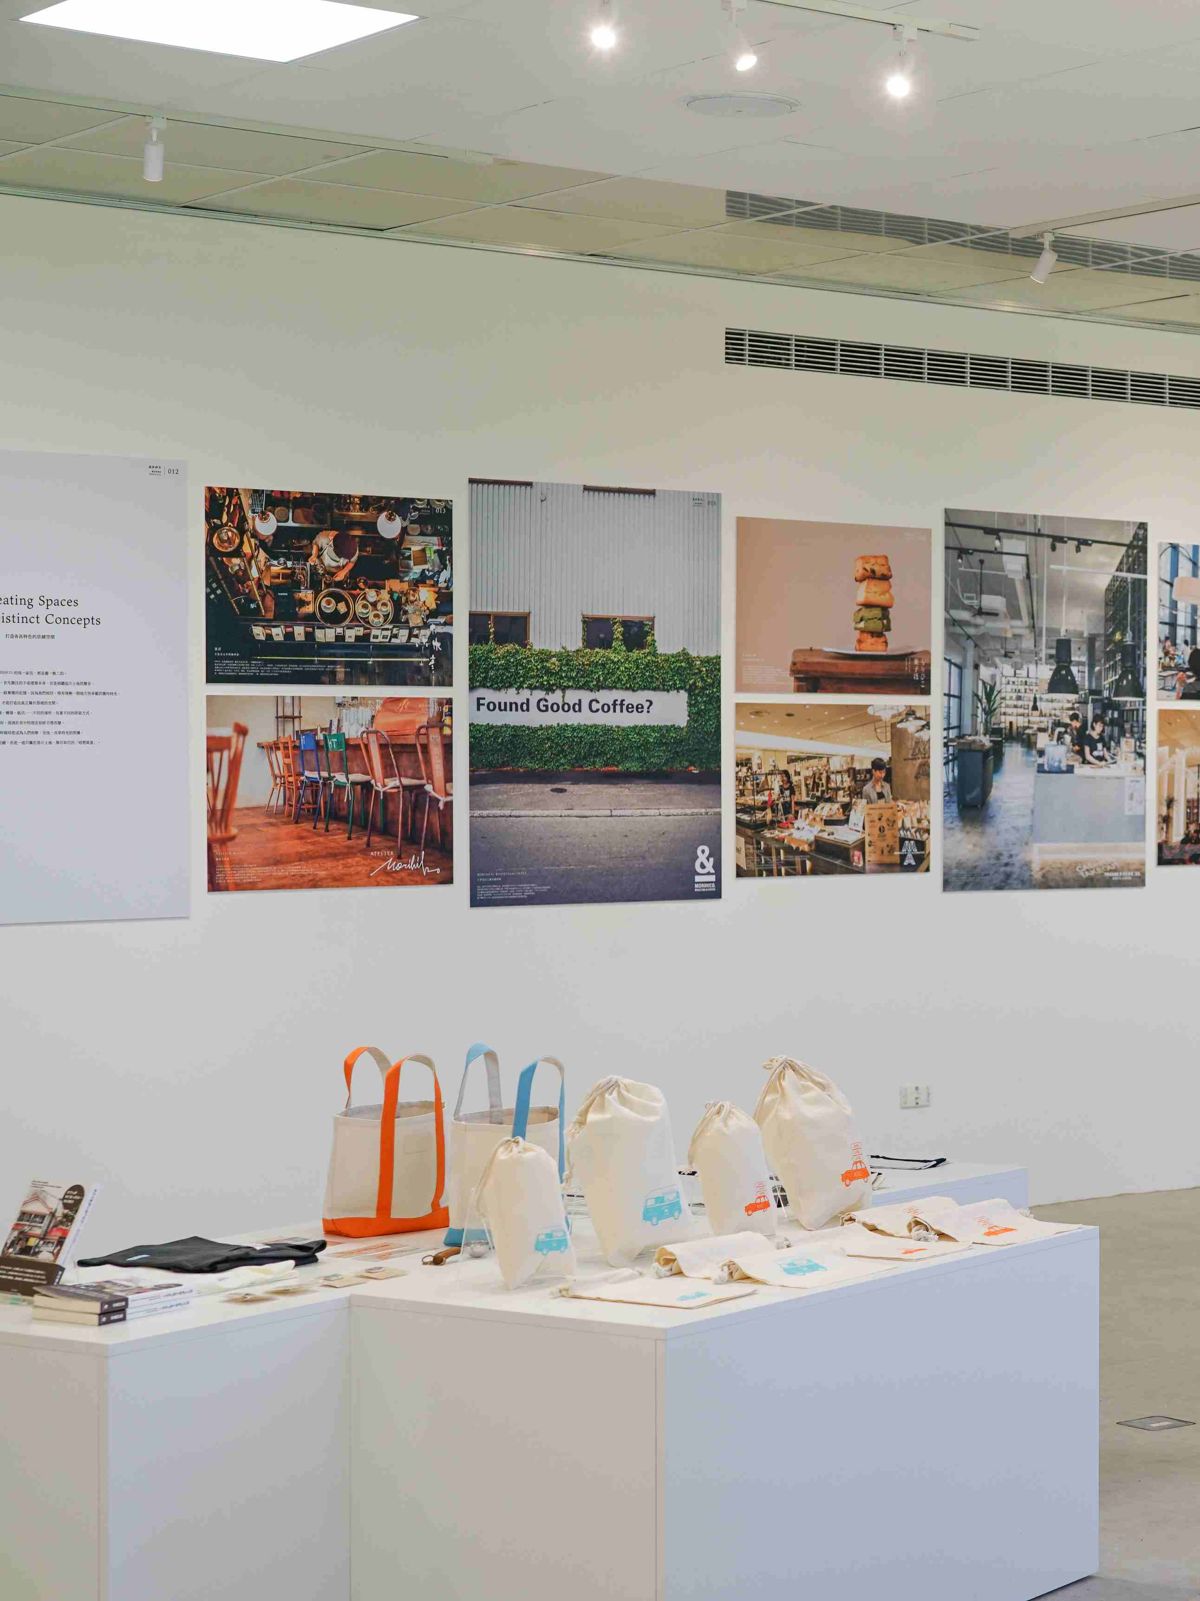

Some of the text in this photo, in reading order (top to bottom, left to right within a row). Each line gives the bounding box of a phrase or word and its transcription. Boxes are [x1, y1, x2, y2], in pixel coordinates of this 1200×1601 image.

[38, 595, 79, 609] Spaces
[1, 612, 101, 629] istinct Concepts
[476, 697, 654, 714] Found Good Coffee?
